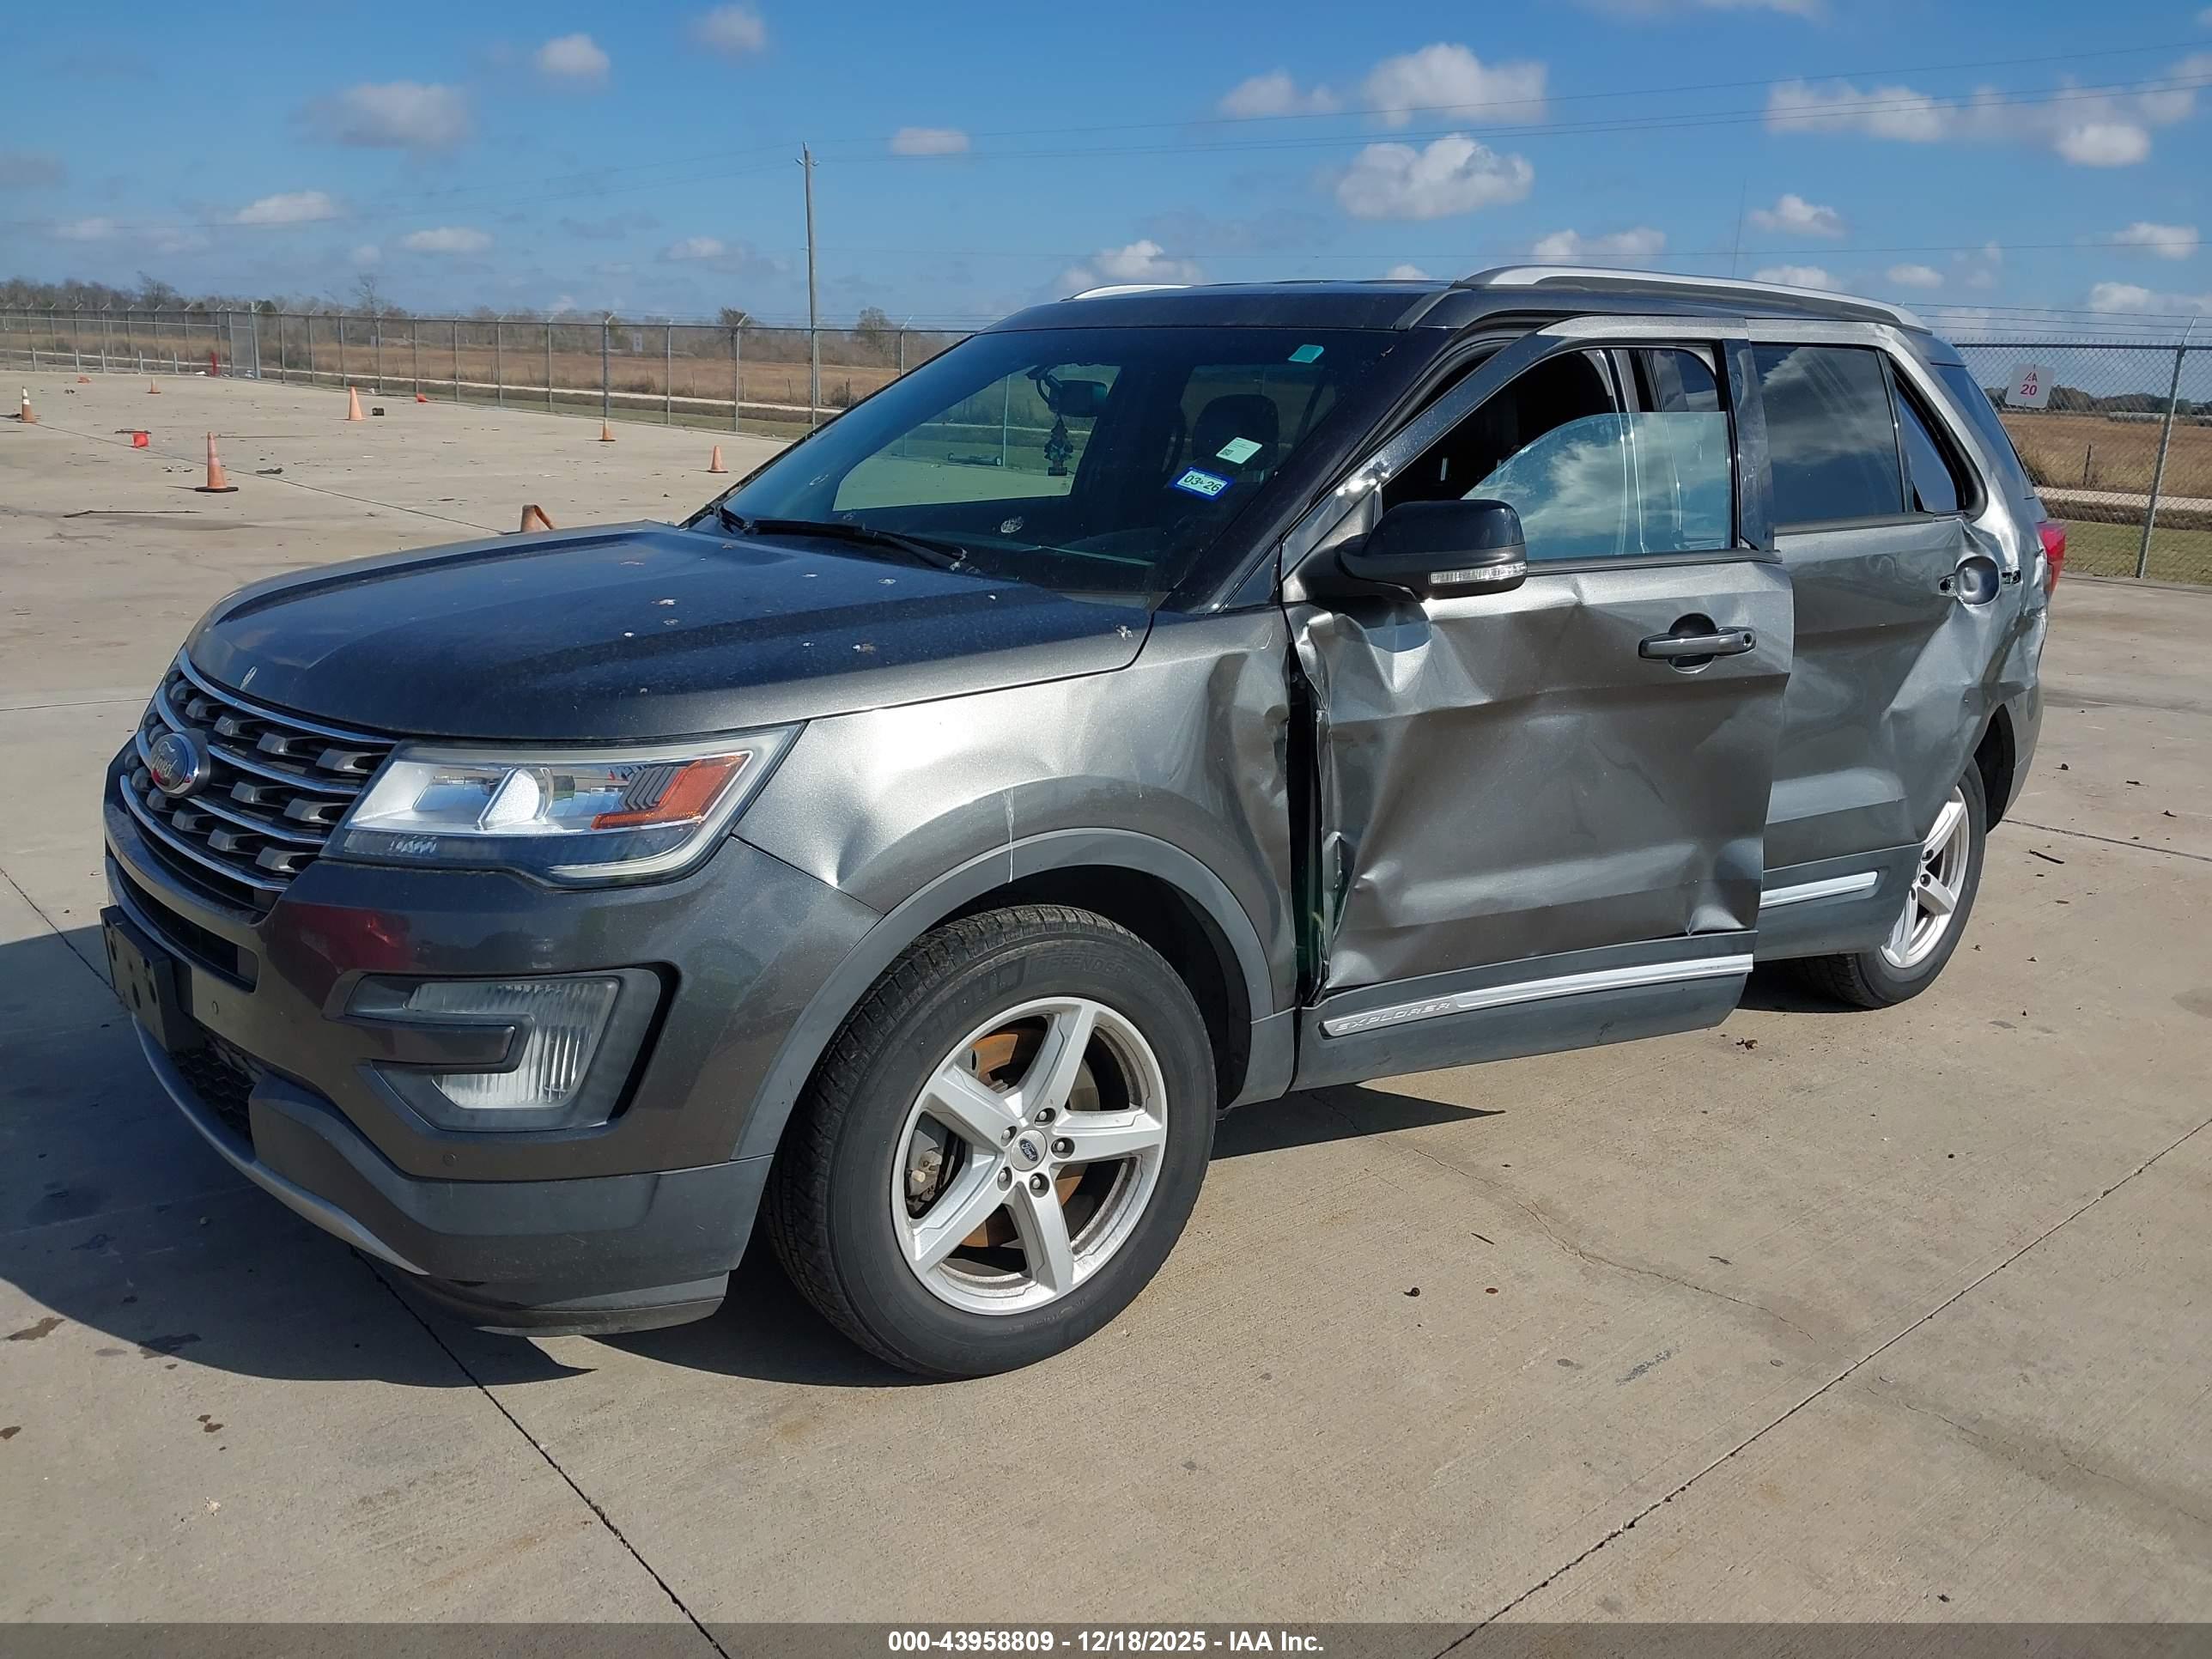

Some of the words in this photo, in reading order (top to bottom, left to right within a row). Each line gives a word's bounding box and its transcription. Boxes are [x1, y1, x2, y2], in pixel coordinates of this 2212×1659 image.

[2020, 384, 2038, 396] 20
[1183, 475, 1201, 485] 03
[1203, 481, 1222, 492] 26
[1335, 1002, 1450, 1031] EXPLORER
[1022, 1141, 1036, 1160] Ford
